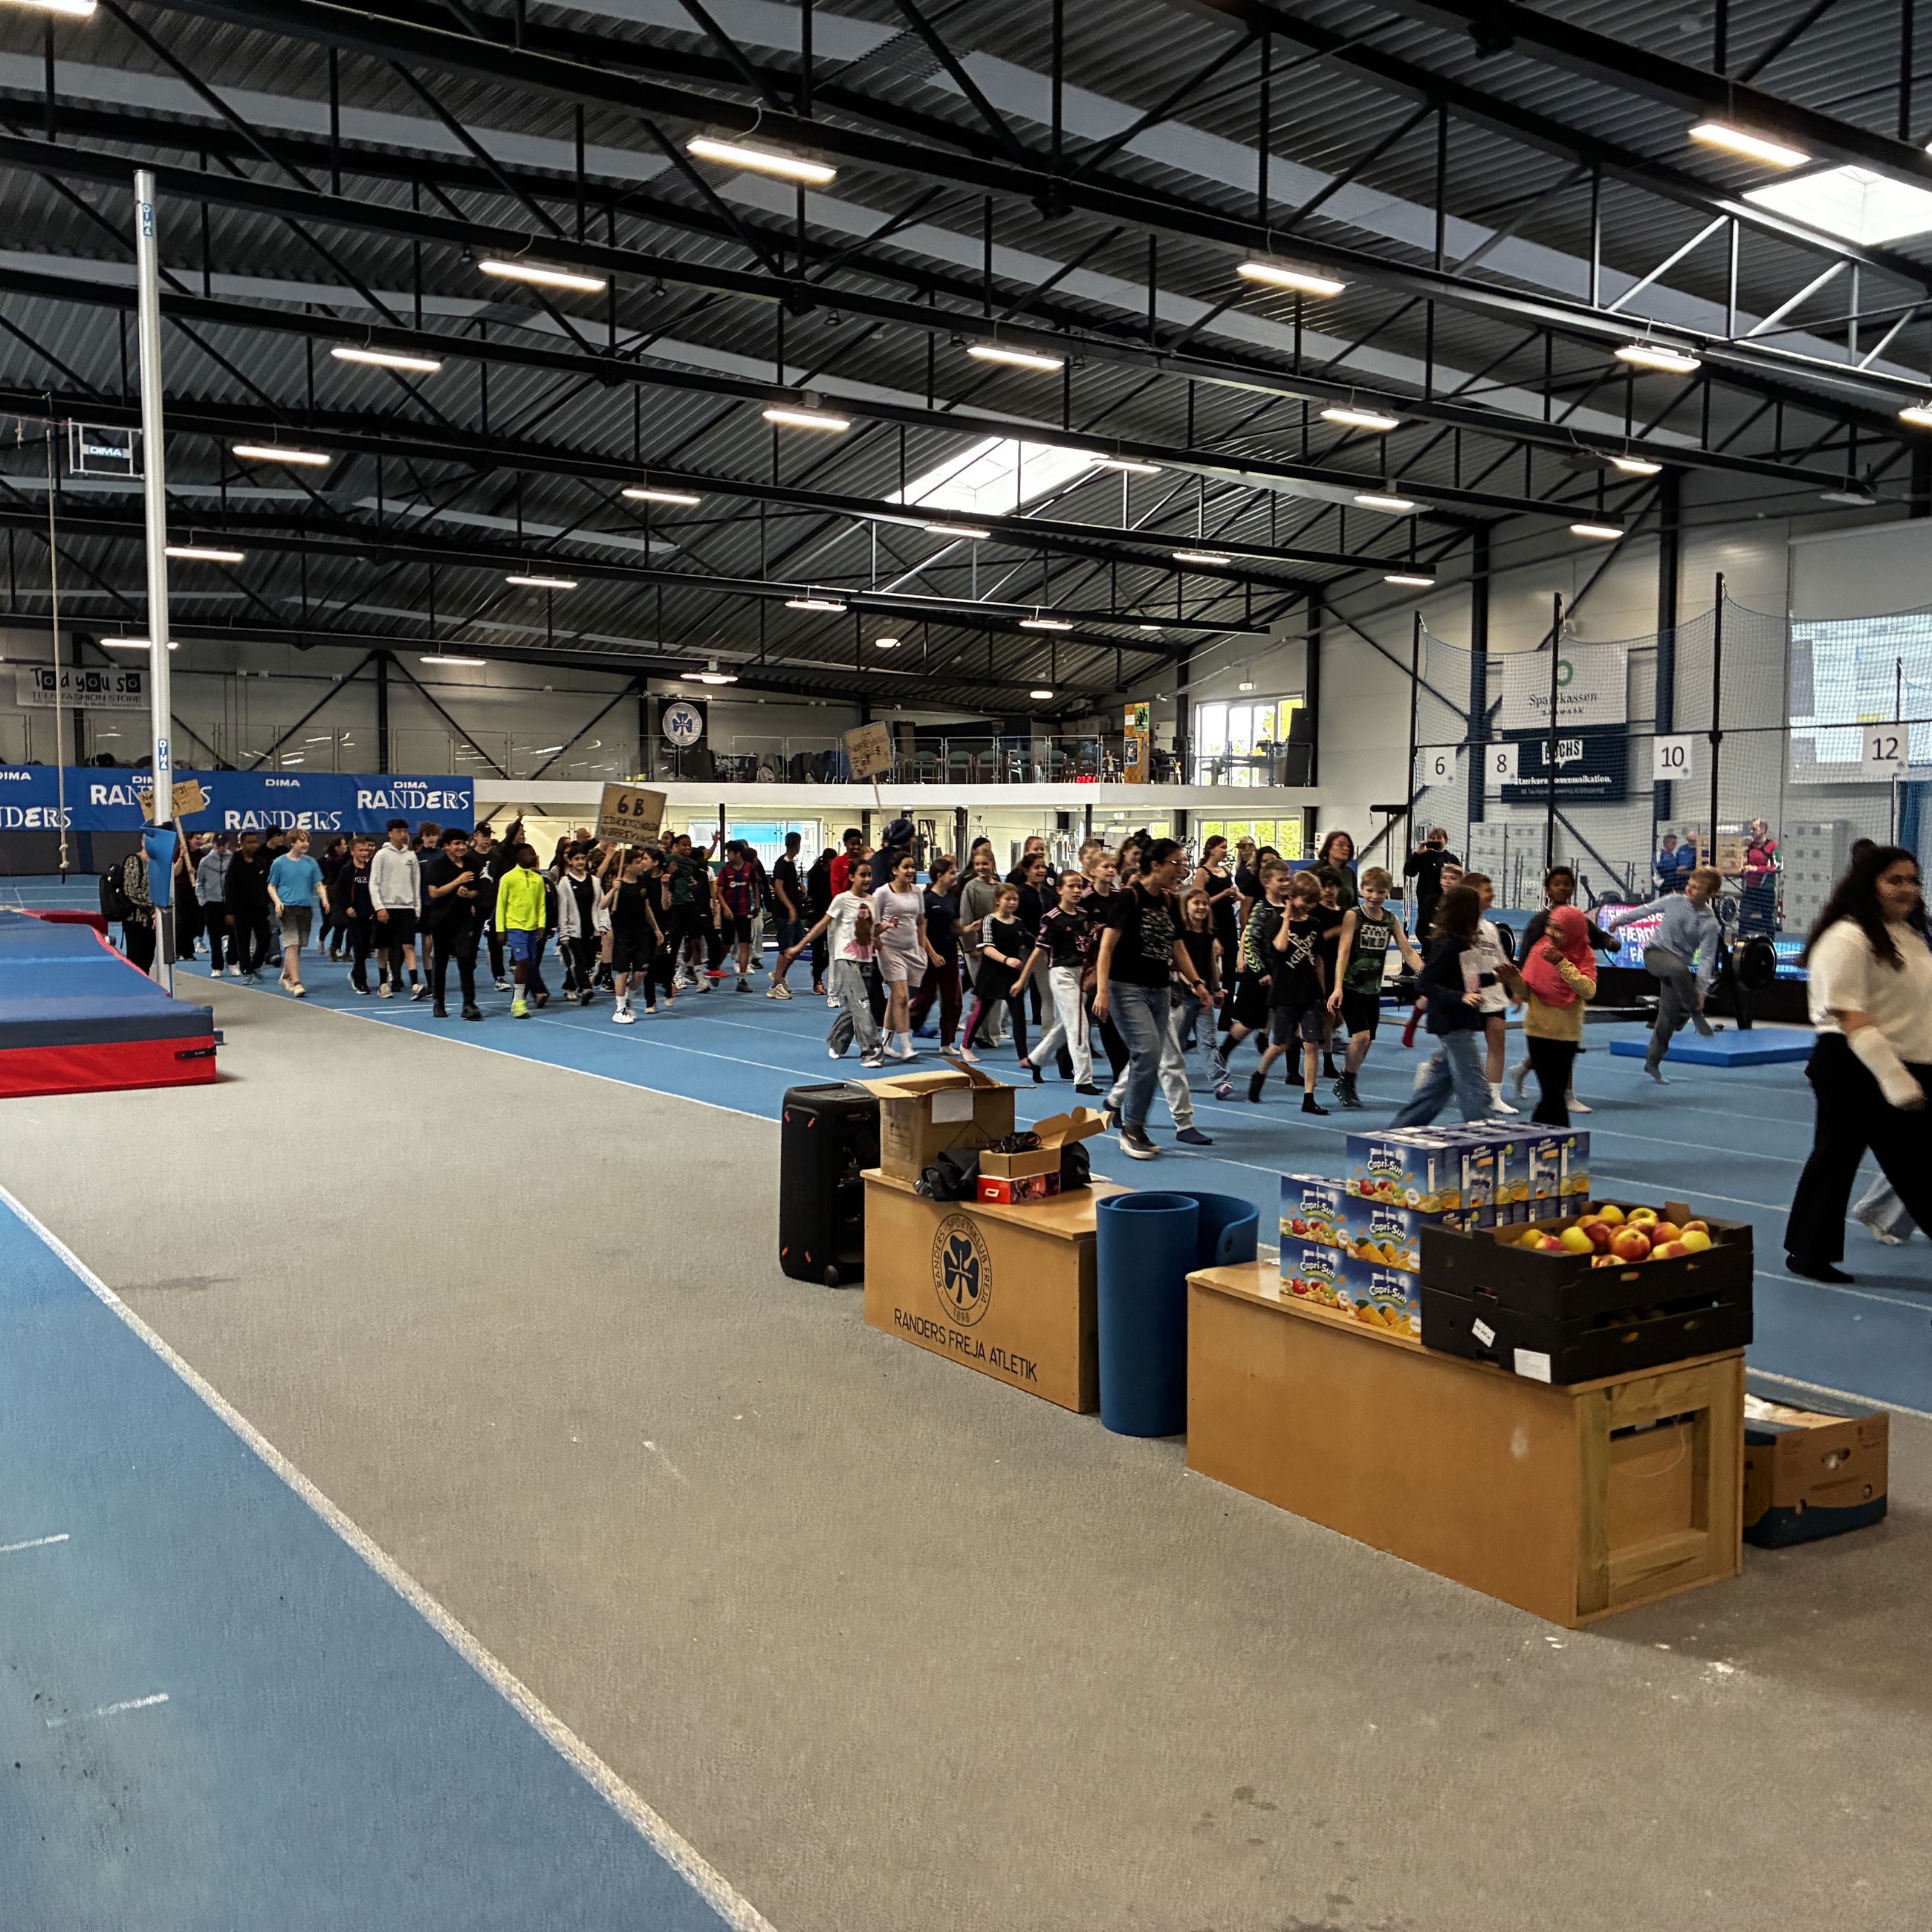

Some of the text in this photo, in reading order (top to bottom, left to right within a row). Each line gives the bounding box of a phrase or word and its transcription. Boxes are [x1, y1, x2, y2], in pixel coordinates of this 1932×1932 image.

[89, 447, 123, 457] DIMA
[29, 667, 141, 693] Tod you so
[108, 693, 143, 704] STORE
[1529, 693, 1597, 708] Spakassen
[159, 739, 167, 770] DIMA
[1661, 746, 1685, 768] 10
[1872, 737, 1899, 761] 12
[1435, 756, 1445, 775] 6
[1497, 754, 1507, 773] 8
[265, 779, 300, 788] DIMA
[393, 781, 428, 789] DIMA
[1554, 774, 1612, 784] ommunikation.
[357, 790, 470, 810] RANDERS
[617, 794, 644, 817] 6 B
[0, 806, 73, 829] DERS
[224, 810, 342, 831] RANDERS
[1367, 1159, 1404, 1176] Capri-Sun
[1300, 1201, 1335, 1219] Capri-Sun
[1369, 1222, 1407, 1240] Capri-Sun
[933, 1230, 945, 1288] RANDERS
[981, 1267, 991, 1303] FREJA
[1300, 1260, 1335, 1279] Capri-Sun
[1369, 1284, 1407, 1303] Capri-Sun
[953, 1308, 970, 1323] 1898
[895, 1308, 1037, 1383] RANDERS FREJA ATLETIK
